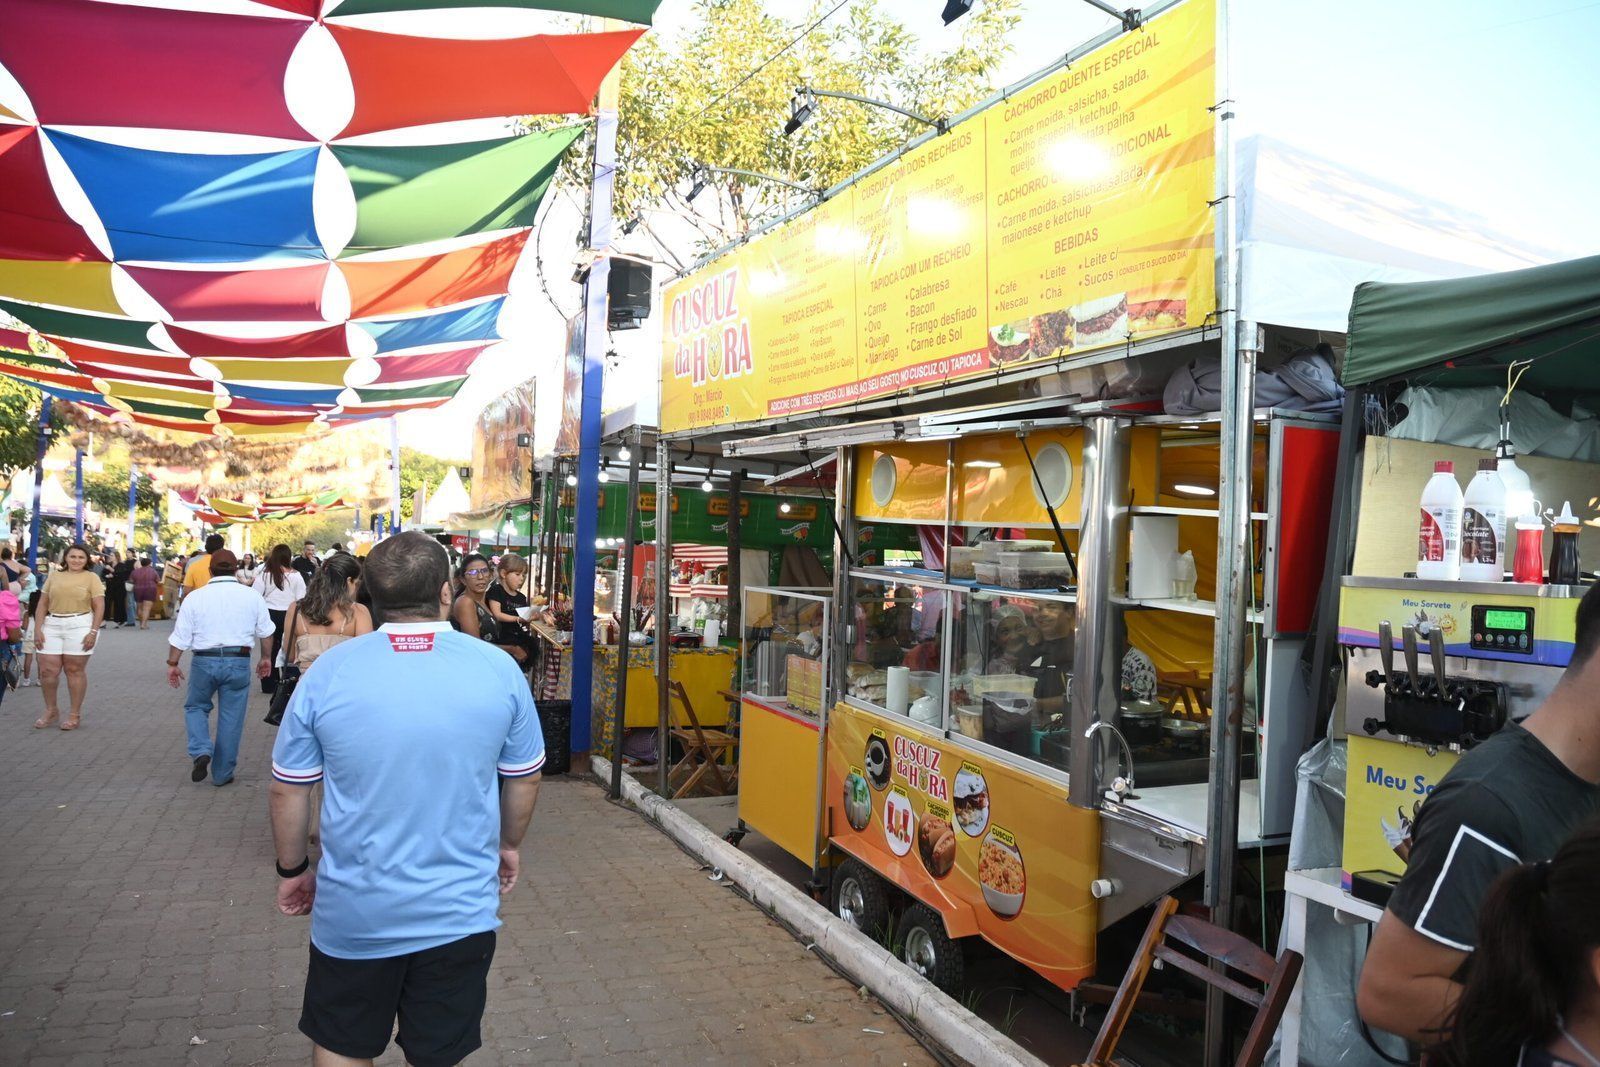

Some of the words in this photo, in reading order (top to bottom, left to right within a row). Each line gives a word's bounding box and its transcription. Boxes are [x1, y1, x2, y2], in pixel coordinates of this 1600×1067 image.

[1004, 85, 1057, 122] CACHORRO
[1059, 62, 1101, 94] QUENTE
[1104, 32, 1160, 71] ESPECIAL
[1010, 122, 1034, 144] Carne
[1068, 88, 1110, 116] salsicha,
[1112, 67, 1149, 95] salada,
[1010, 137, 1035, 159] molho
[1079, 99, 1121, 128] ketchup,
[1010, 155, 1035, 176] queijo
[1106, 110, 1135, 136] palha
[861, 177, 889, 201] CUSCUZ
[890, 167, 906, 185] COM
[907, 156, 926, 176] DOIS
[928, 131, 972, 164] RECHEIOS
[997, 174, 1049, 206] CACHORRO
[1103, 123, 1172, 160] ADICIONAL
[1001, 224, 1043, 246] maionese
[1045, 219, 1051, 229] e
[1053, 204, 1092, 228] ketchup
[1002, 210, 1026, 229] Carne
[1054, 228, 1099, 255] BEBIDAS
[870, 271, 899, 293] TAPIOCA
[900, 262, 917, 278] COM
[919, 258, 931, 273] UM
[933, 241, 971, 268] RECHEIO
[1084, 252, 1107, 269] Leite
[1109, 247, 1119, 262] c/
[1045, 266, 1066, 281] Leite
[1084, 270, 1114, 287] Sucos
[909, 279, 950, 301] Calabresa
[1000, 281, 1017, 296] Café
[1045, 287, 1063, 300] Chá
[671, 269, 738, 338] CUSCUZ
[782, 309, 805, 325] TAPIOCA
[805, 298, 834, 318] ESPECIAL
[867, 301, 887, 318] Carne
[910, 301, 935, 318] Bacon
[1000, 295, 1029, 312] Nescau
[868, 320, 881, 332] Ovo
[910, 319, 939, 335] Frango
[940, 306, 977, 327] desfiado
[868, 334, 890, 350] Queijo
[911, 337, 934, 352] Carne
[936, 332, 947, 346] de
[948, 328, 963, 342] Sol
[675, 343, 691, 376] da
[868, 346, 899, 365] Manteiga
[813, 389, 837, 404] RECHEIOS
[837, 386, 846, 398] OU
[859, 382, 868, 393] AO
[868, 378, 879, 391] SEU
[900, 370, 909, 381] NO
[910, 363, 938, 379] CUSCUZ
[939, 360, 950, 374] OU
[951, 352, 982, 370] TAPIOCA
[1403, 599, 1419, 608] Meu
[1421, 600, 1452, 609] Sorvete
[894, 736, 940, 772] CUSCUZ
[897, 759, 908, 777] da
[963, 763, 981, 775] TAPIOCA
[1366, 765, 1407, 792] Meu
[991, 827, 1013, 843] CUSCUZ
